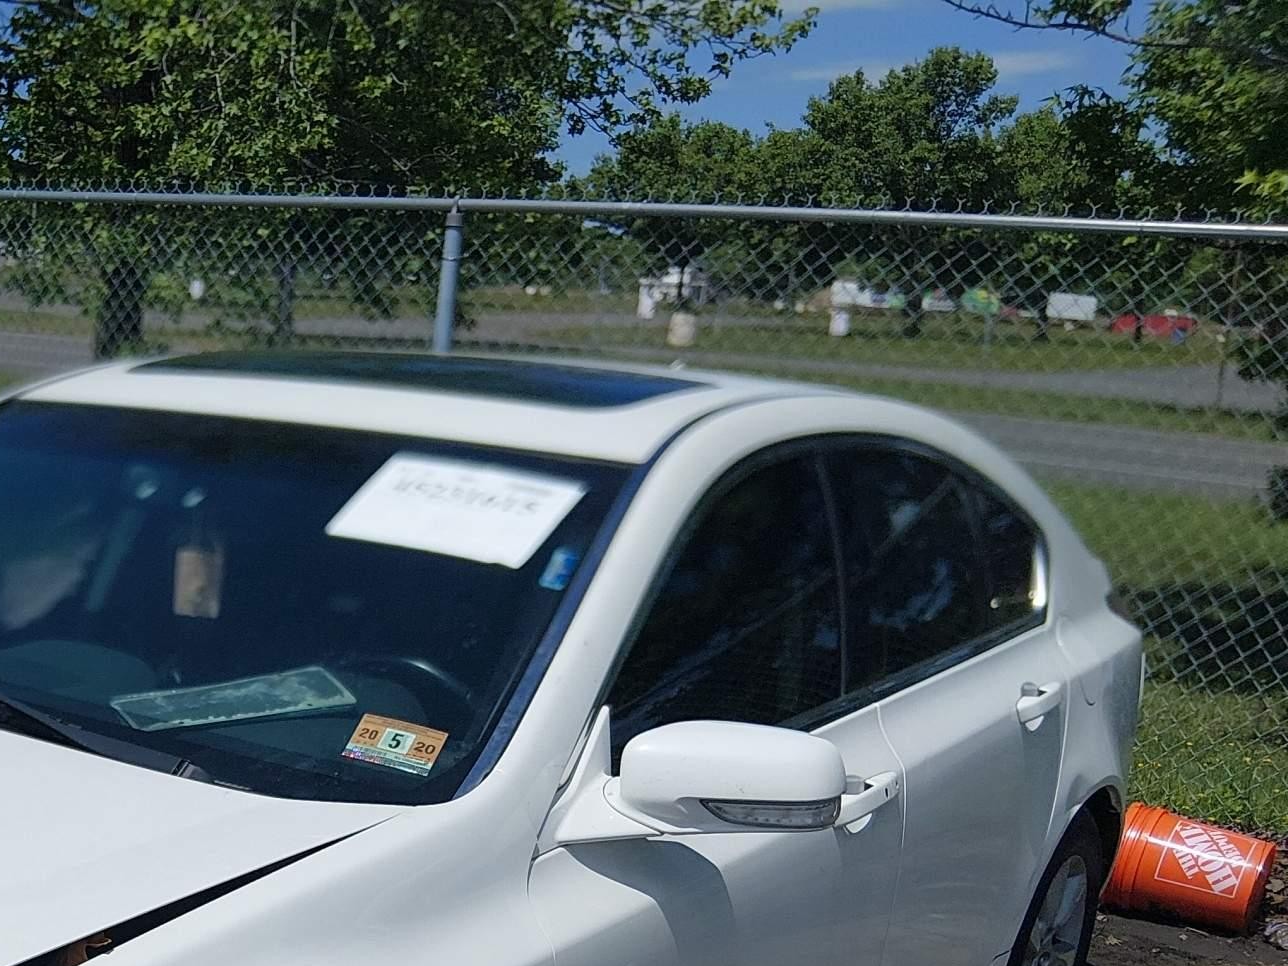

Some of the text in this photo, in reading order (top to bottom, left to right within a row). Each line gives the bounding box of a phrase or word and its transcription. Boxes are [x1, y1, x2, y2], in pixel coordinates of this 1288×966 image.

[359, 728, 378, 740] 20
[388, 733, 404, 749] 5
[414, 741, 436, 754] 20
[1178, 826, 1239, 892] HOME
[1207, 830, 1244, 868] DEPOT
